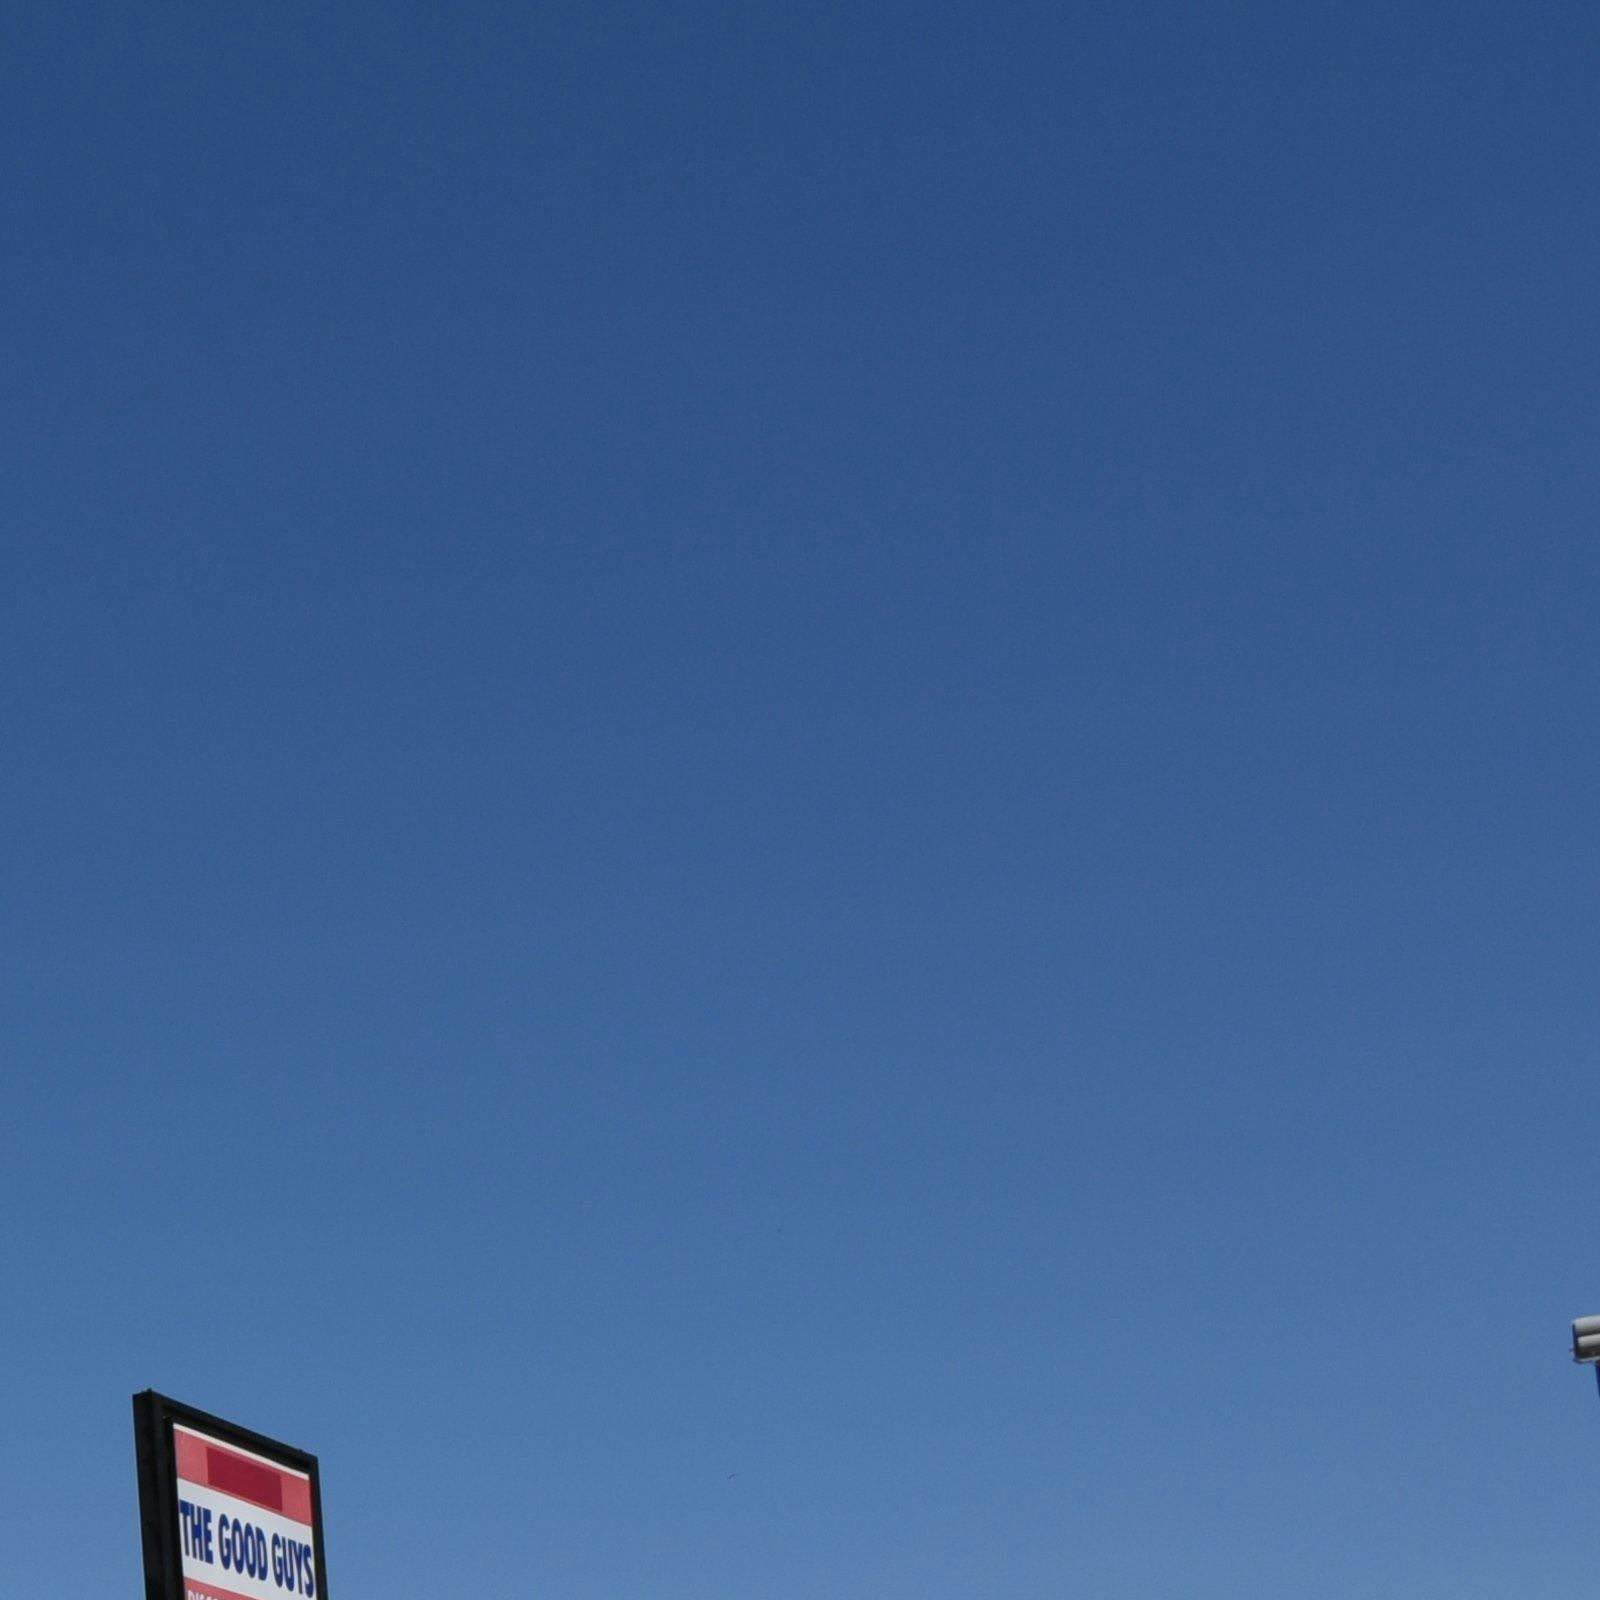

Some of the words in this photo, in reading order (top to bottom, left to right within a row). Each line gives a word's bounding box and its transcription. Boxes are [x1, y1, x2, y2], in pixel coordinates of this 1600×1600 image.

[180, 1500, 213, 1565] THE
[218, 1513, 268, 1581] GOOD
[272, 1532, 314, 1599] GUYS
